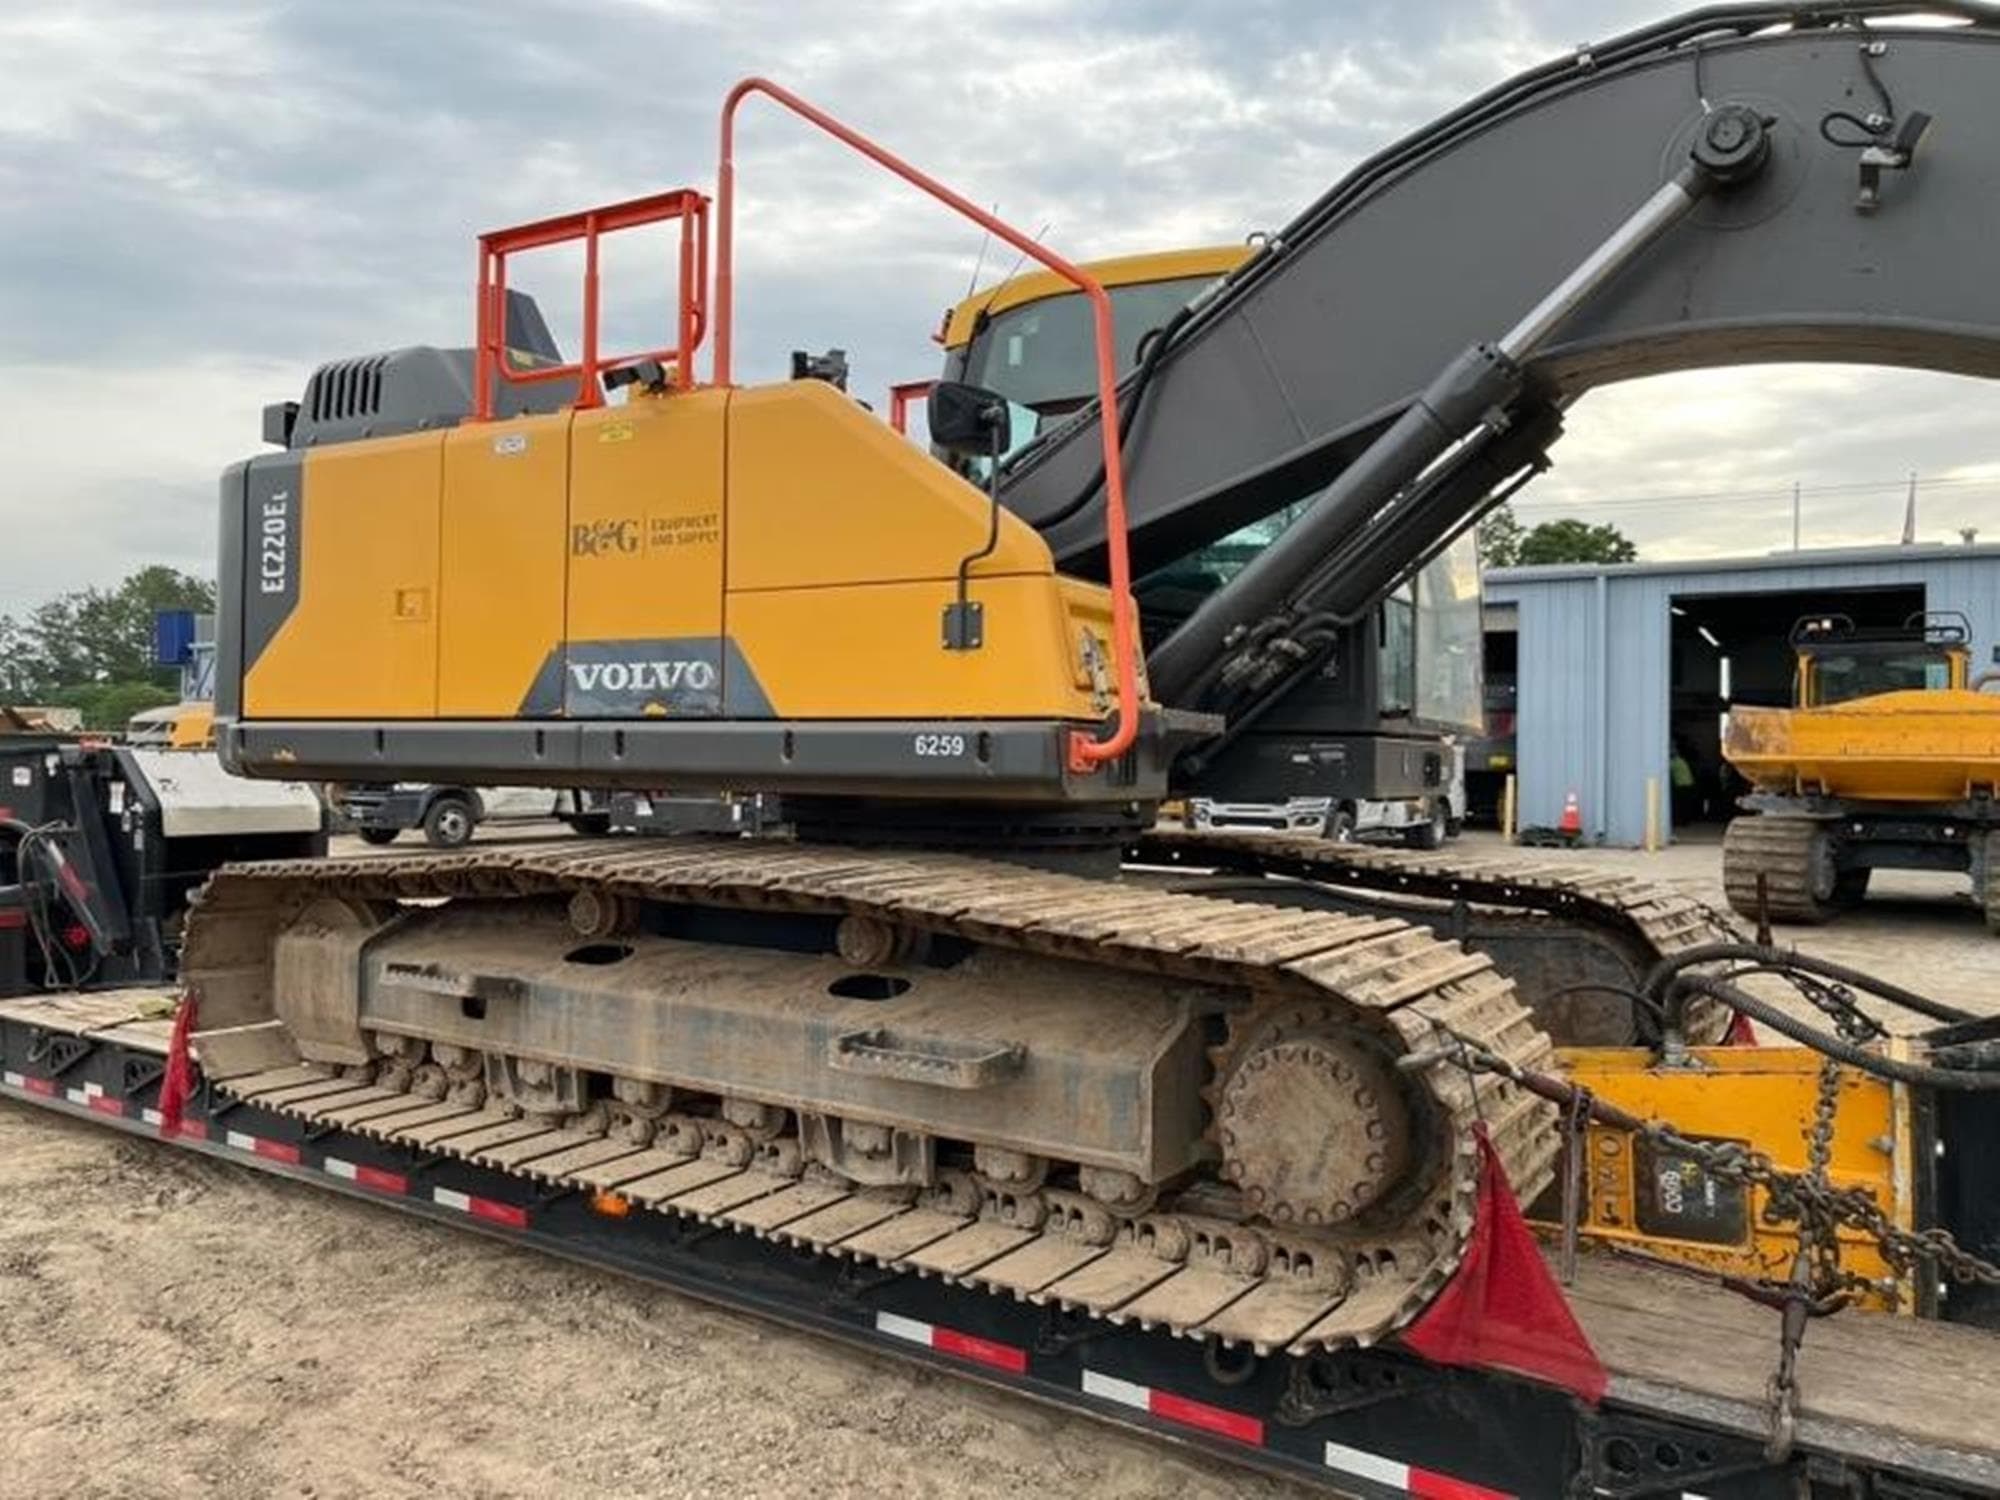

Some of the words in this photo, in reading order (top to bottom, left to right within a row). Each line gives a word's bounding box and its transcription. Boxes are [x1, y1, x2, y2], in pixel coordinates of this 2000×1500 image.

[572, 518, 639, 556] B&G
[567, 661, 715, 691] VOLVO
[915, 735, 965, 756] 6259
